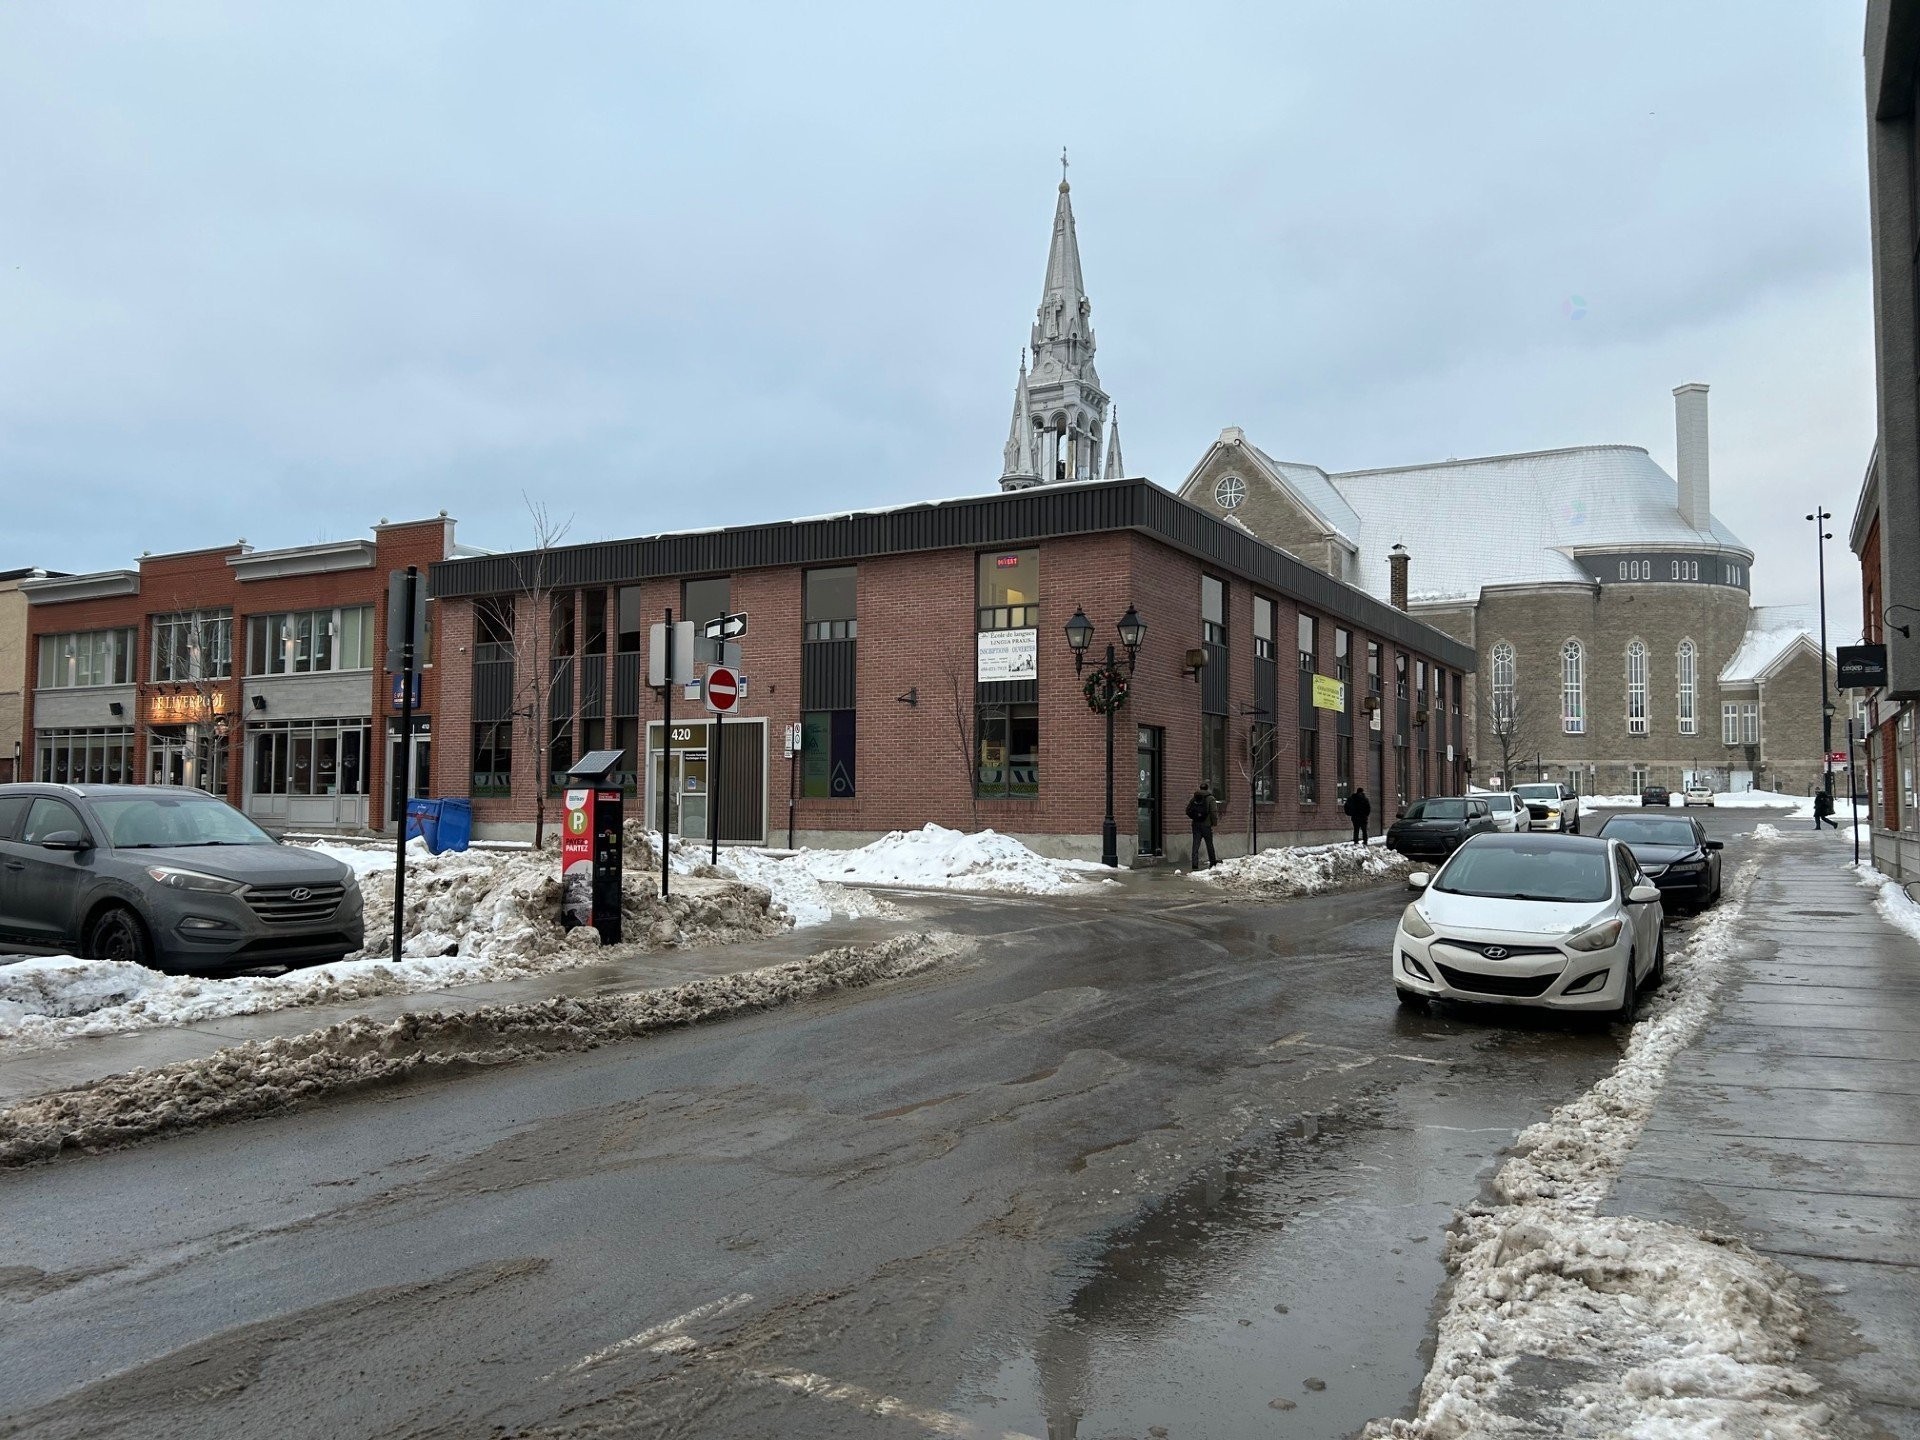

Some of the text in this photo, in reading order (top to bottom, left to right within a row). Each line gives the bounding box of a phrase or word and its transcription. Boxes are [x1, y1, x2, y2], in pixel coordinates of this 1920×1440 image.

[1014, 630, 1035, 638] langues
[152, 694, 225, 710] LE LIVERPOOL
[671, 728, 691, 741] 420
[565, 838, 585, 846] PAYEZ
[565, 844, 589, 852] PARTEZ
